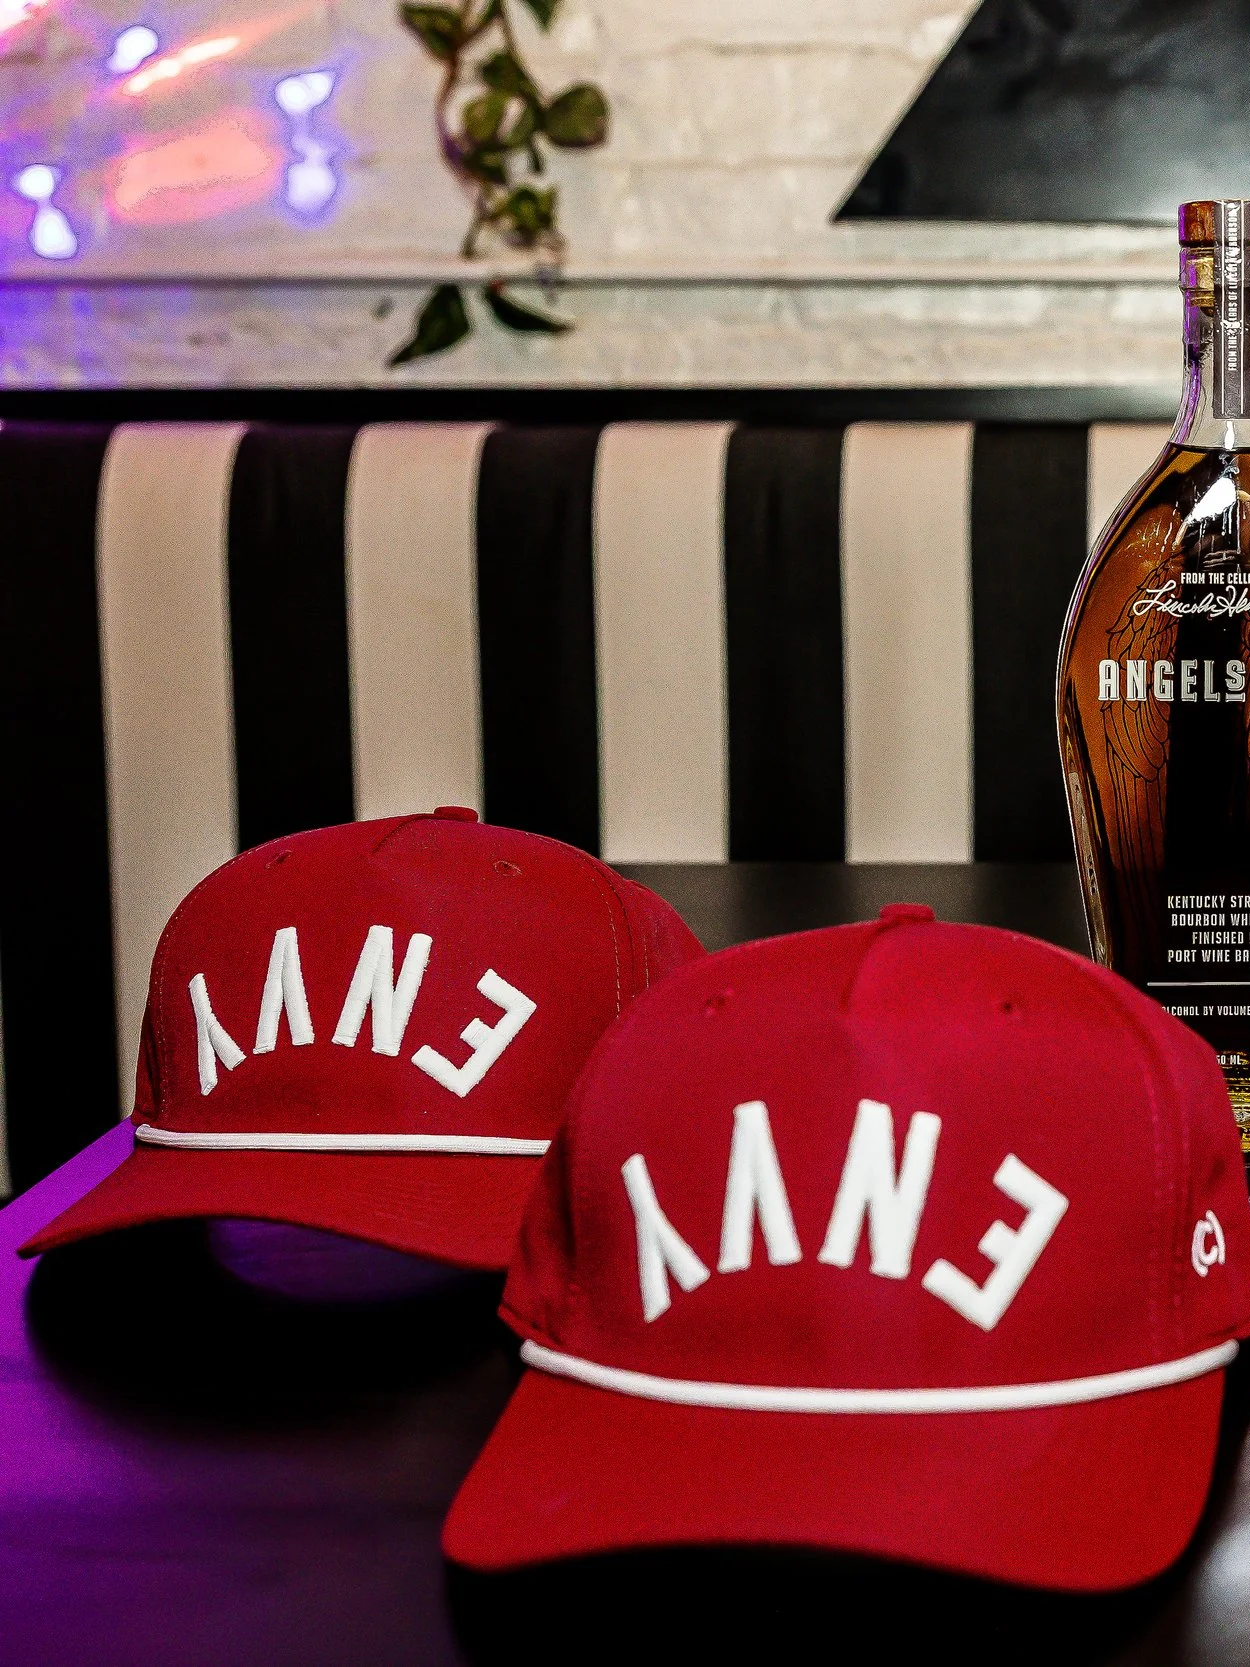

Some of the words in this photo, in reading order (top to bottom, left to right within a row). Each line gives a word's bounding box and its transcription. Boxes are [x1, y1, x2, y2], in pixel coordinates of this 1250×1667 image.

[1228, 291, 1238, 301] OF
[1228, 336, 1238, 349] THE
[1228, 351, 1238, 371] FROM
[1181, 573, 1205, 584] FROM
[1209, 573, 1225, 584] THE
[1133, 579, 1218, 617] Lincoln
[1167, 895, 1226, 909] KENTUCKY
[1171, 913, 1225, 926] BOURBON
[1192, 931, 1244, 945] FINISHED
[1167, 949, 1197, 963] PORT
[1201, 949, 1231, 963] WINE
[189, 925, 537, 1098] ENVY
[1203, 1005, 1214, 1016] BY
[1229, 1054, 1242, 1065] ML
[621, 1098, 1069, 1331] ENVY
